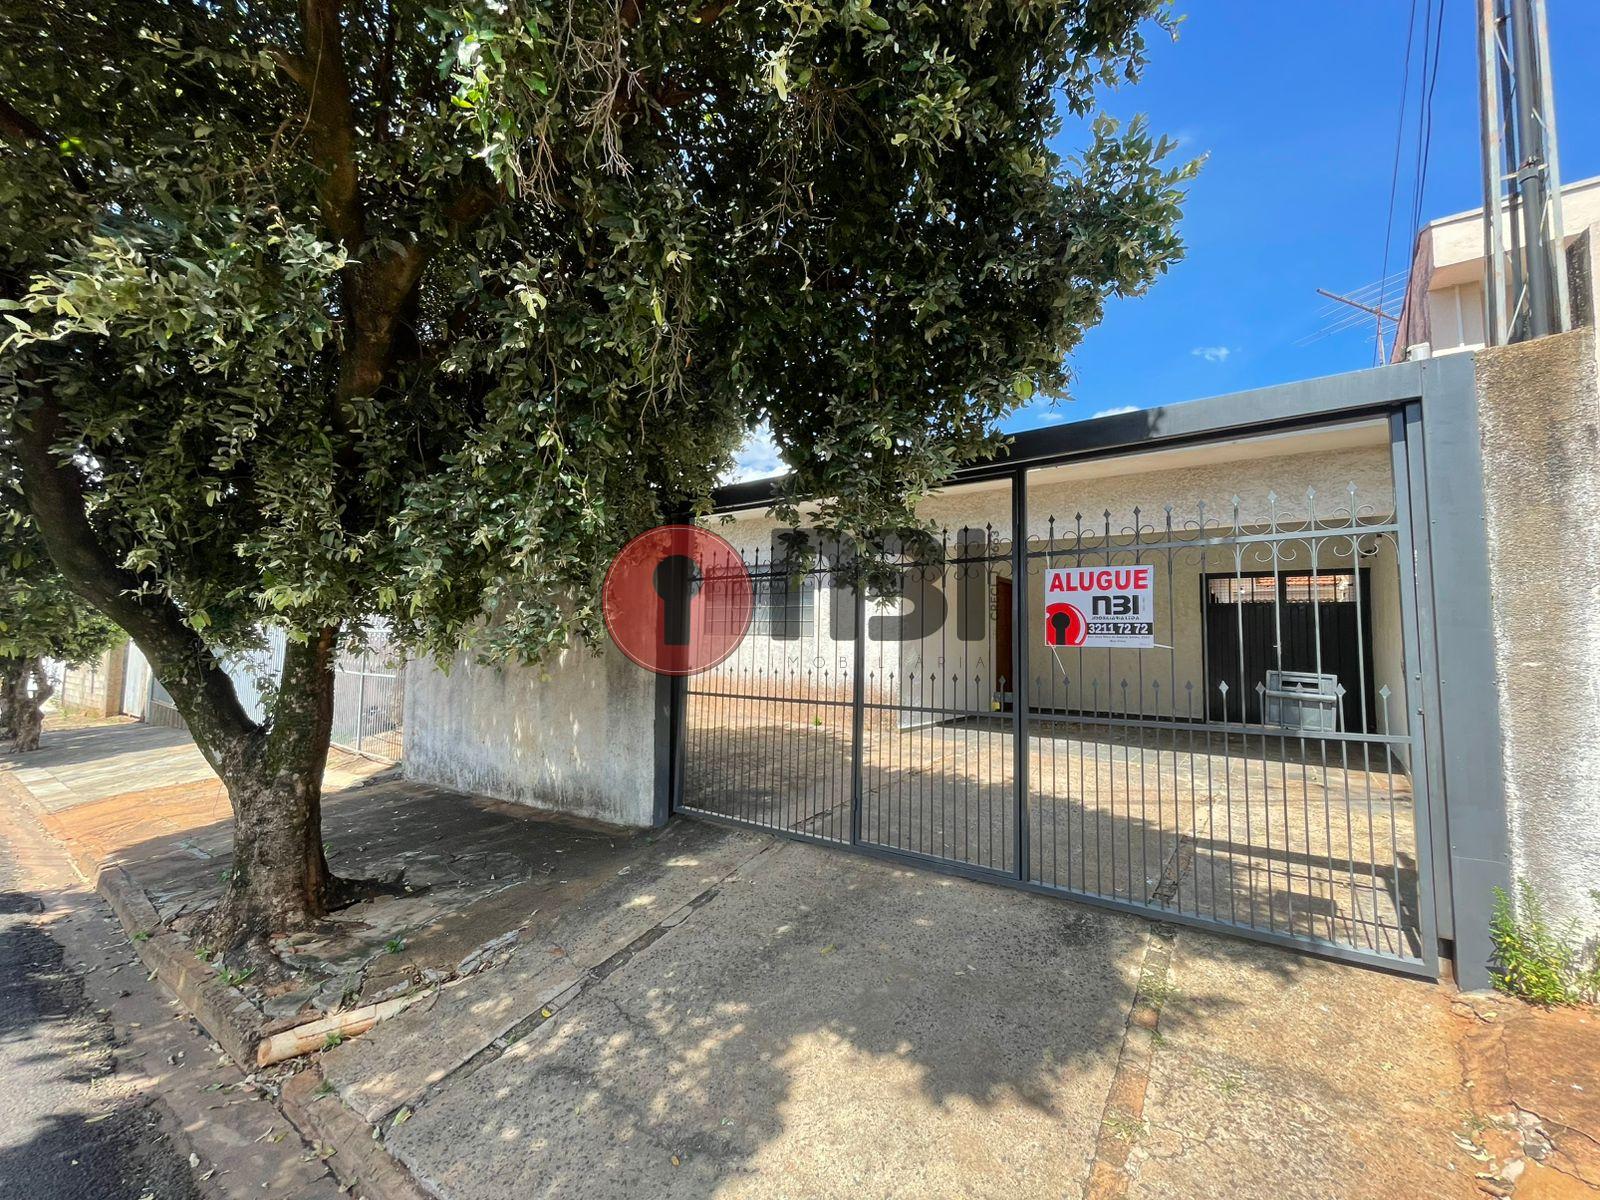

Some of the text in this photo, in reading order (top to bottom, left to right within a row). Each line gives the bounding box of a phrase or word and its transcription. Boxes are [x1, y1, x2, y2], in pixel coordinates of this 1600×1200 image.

[1049, 568, 1149, 592] ALUGUE
[1088, 623, 1148, 634] 3211 72 72
